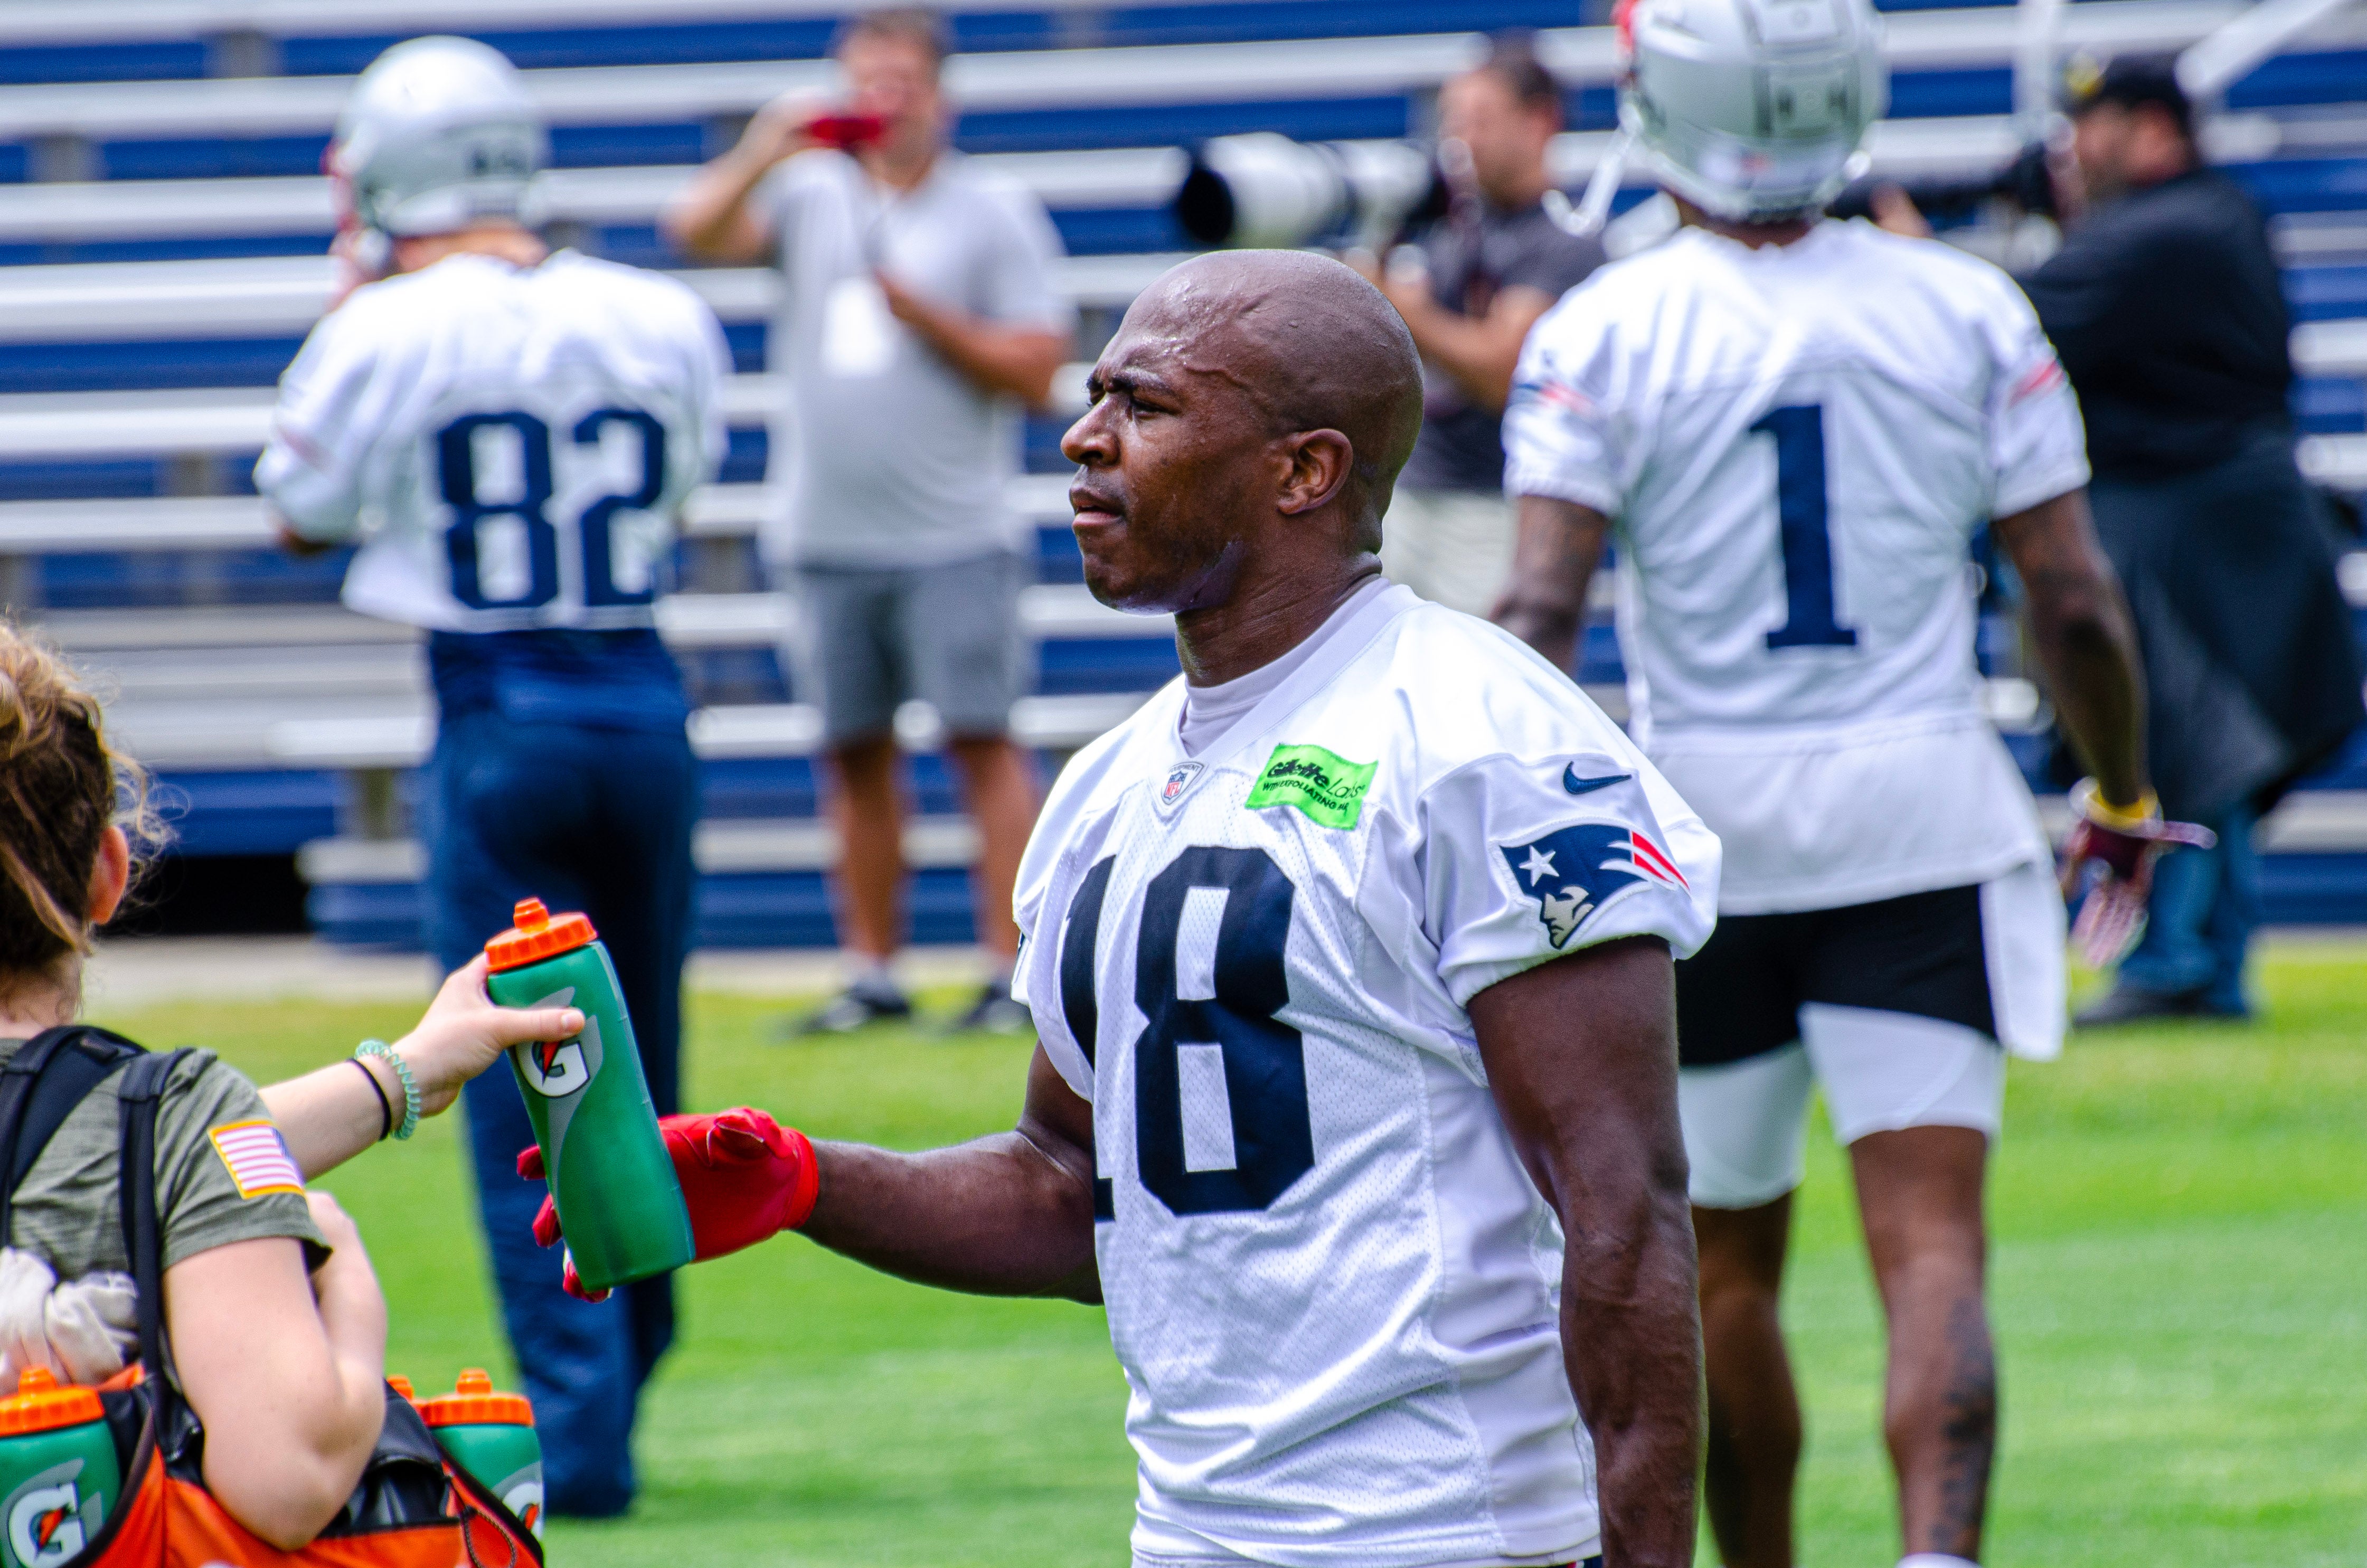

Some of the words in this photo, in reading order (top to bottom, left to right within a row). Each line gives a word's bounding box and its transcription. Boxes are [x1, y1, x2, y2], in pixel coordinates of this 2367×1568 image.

[440, 410, 665, 609] 82
[1750, 404, 1856, 646] 1
[8, 1479, 87, 1568] G
